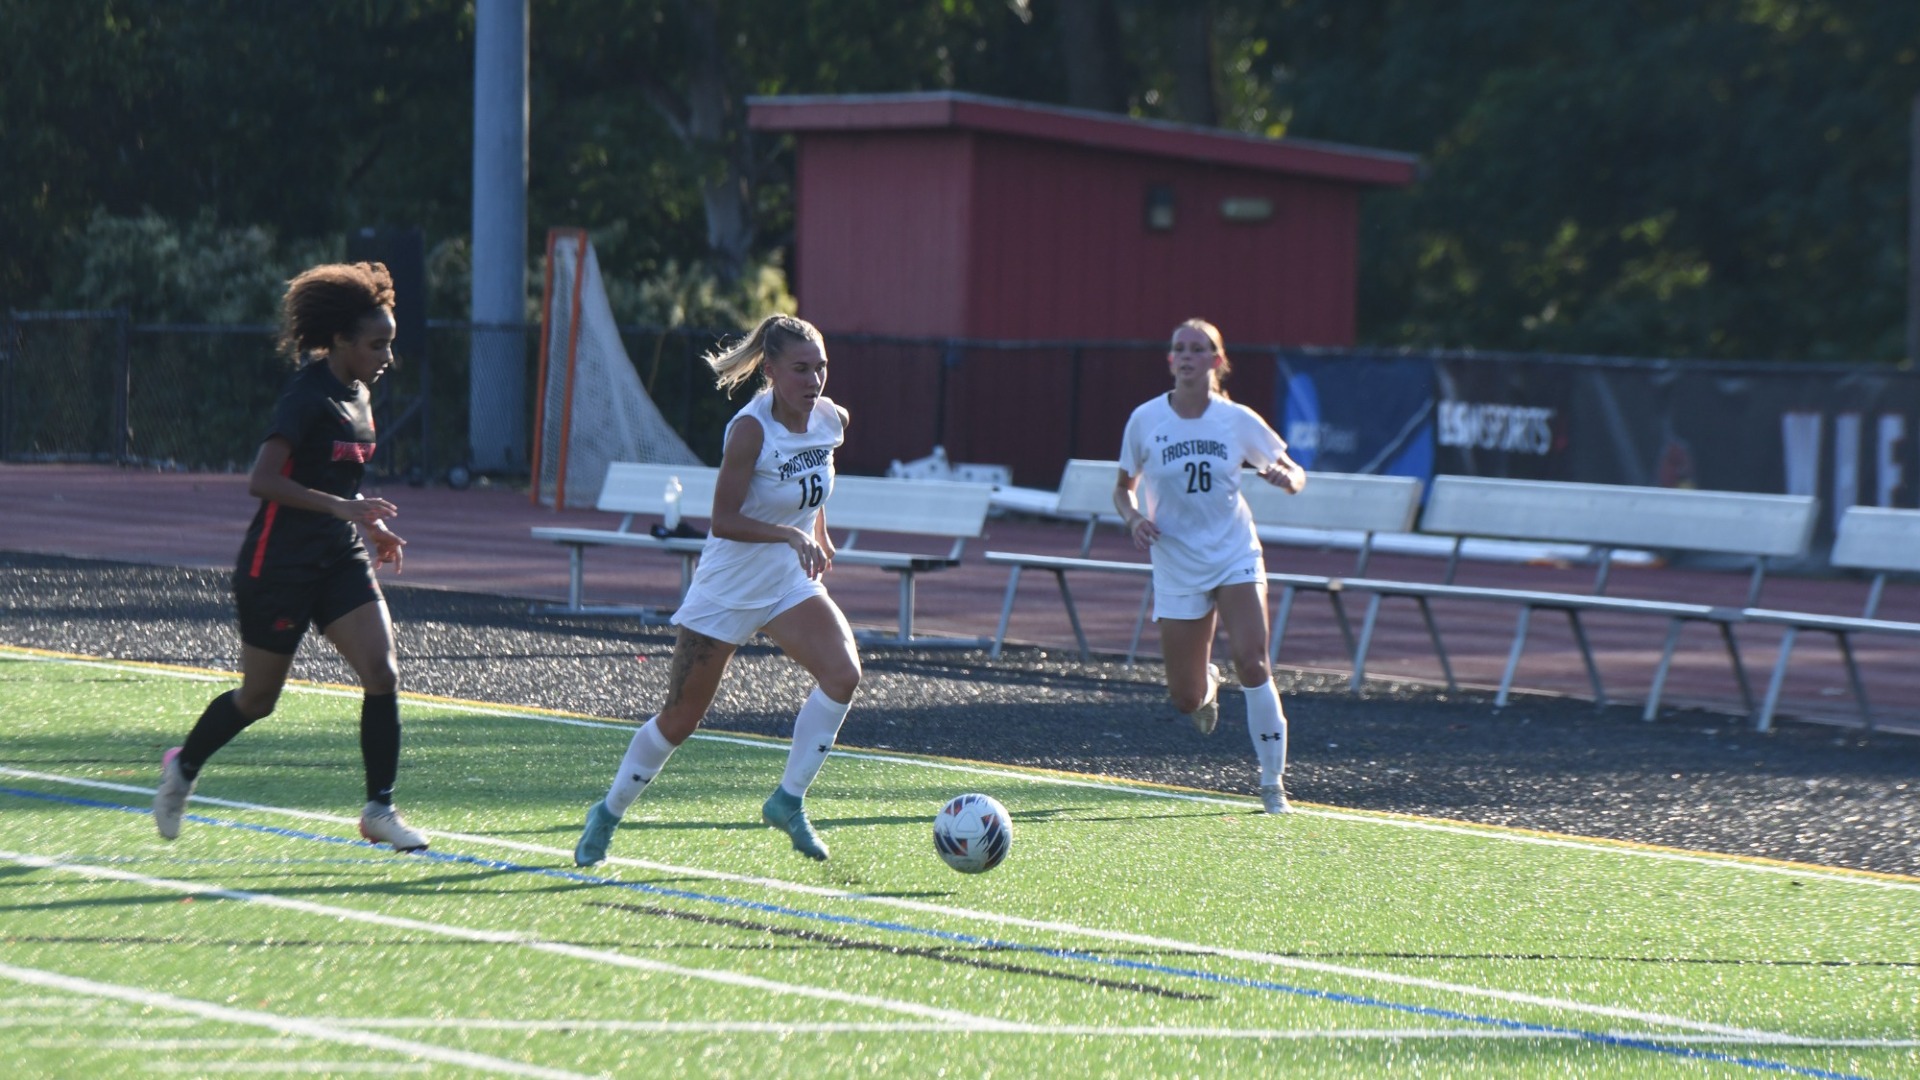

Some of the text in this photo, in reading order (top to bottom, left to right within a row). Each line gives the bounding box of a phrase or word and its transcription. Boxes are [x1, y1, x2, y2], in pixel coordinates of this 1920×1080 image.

[1161, 439, 1228, 466] FROSTBURG
[798, 473, 823, 510] 16
[1184, 461, 1212, 494] 26
